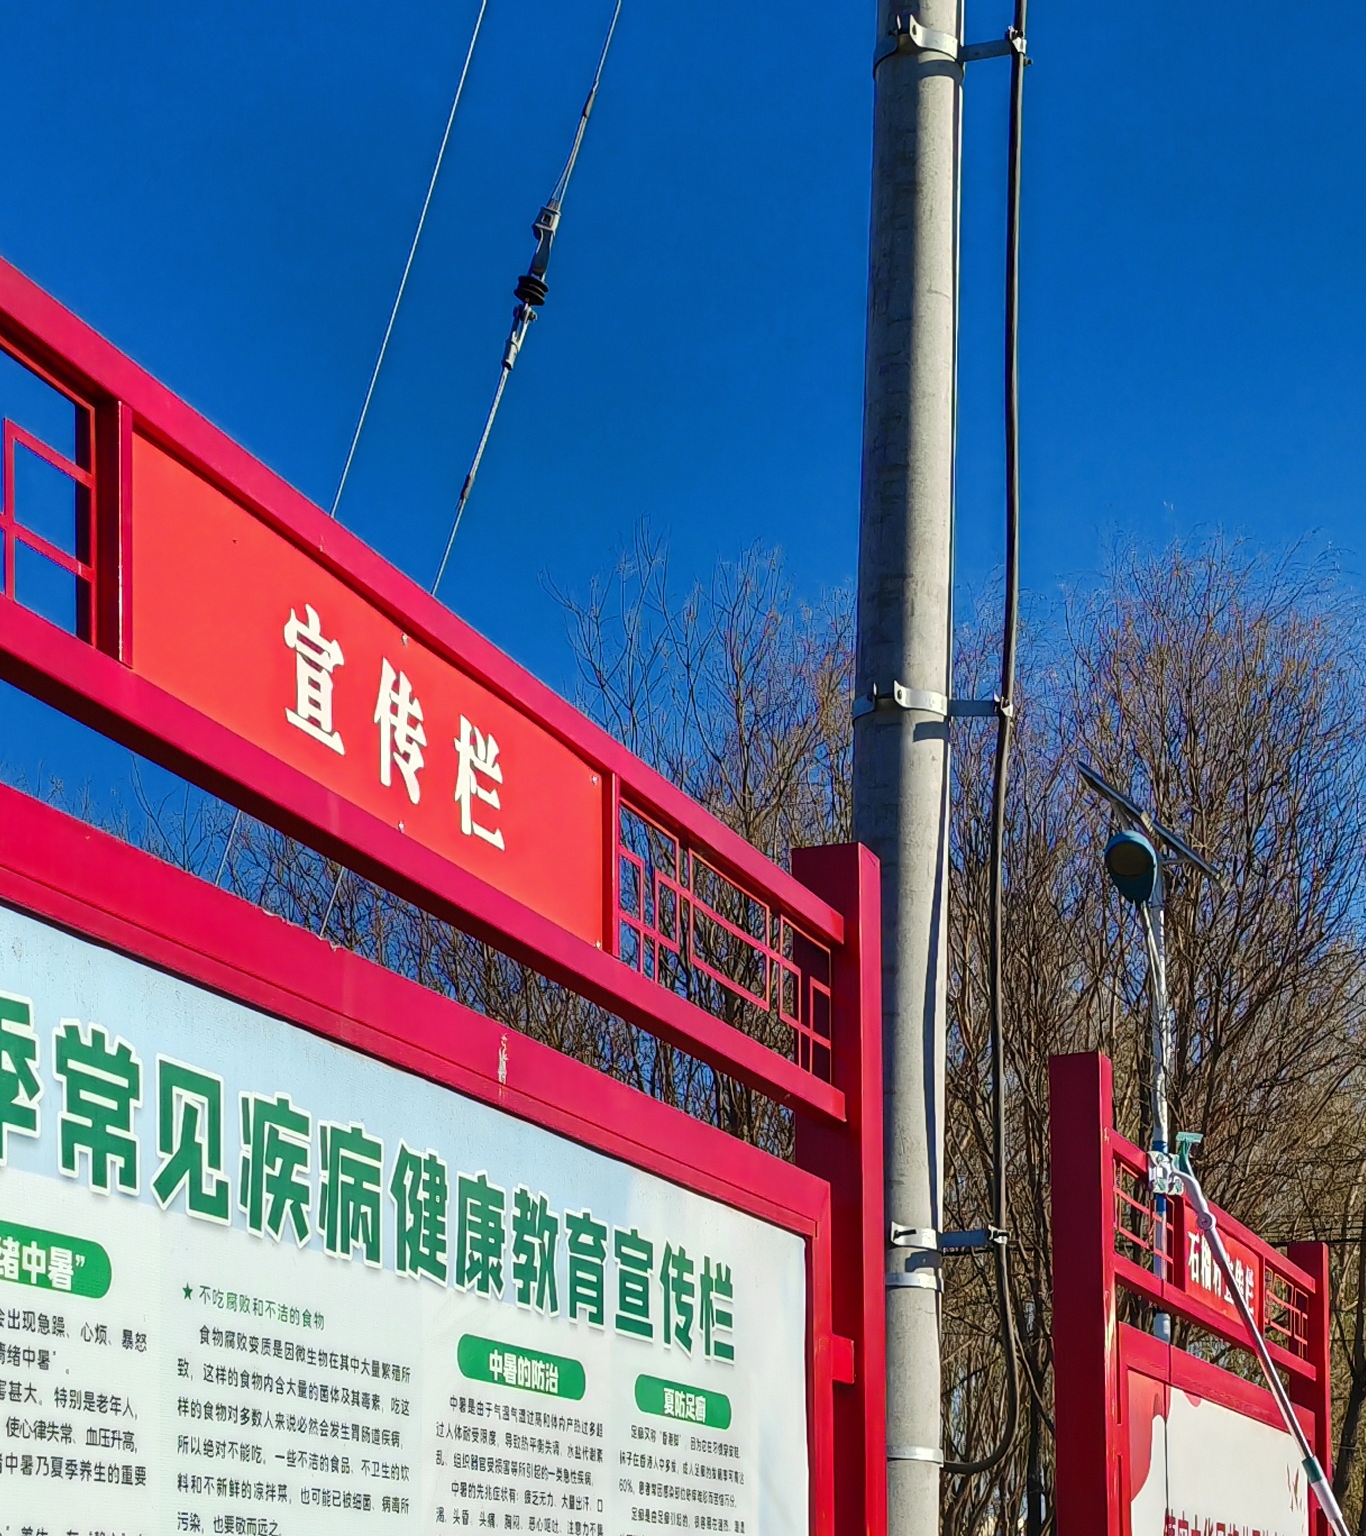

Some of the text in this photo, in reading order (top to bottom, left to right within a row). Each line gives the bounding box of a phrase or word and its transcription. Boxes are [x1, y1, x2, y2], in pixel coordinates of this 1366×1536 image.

[284, 603, 506, 852] 宣传栏
[488, 1348, 559, 1395] 中暑的防治
